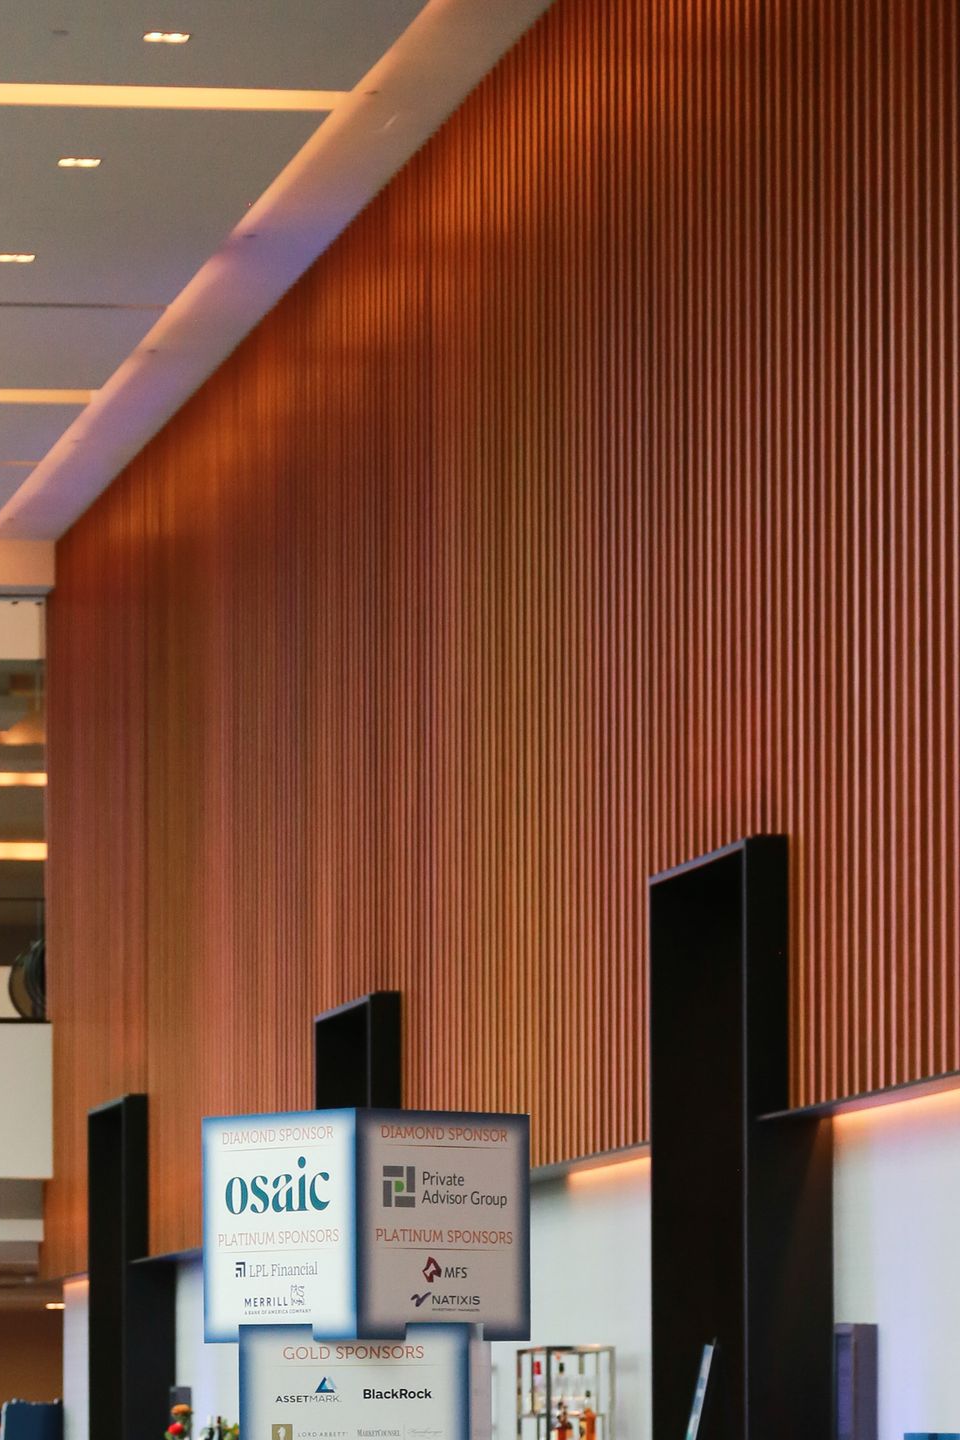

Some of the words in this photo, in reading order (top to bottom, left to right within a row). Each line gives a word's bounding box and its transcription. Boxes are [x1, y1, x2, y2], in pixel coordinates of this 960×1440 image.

[221, 1129, 276, 1145] DIAMOND
[279, 1125, 334, 1142] SPONSOR
[380, 1125, 444, 1140] DIAMOND
[448, 1127, 507, 1142] SPONSOR
[225, 1156, 331, 1215] osaic
[422, 1171, 465, 1187] Private
[421, 1190, 468, 1205] Advisor
[470, 1191, 507, 1208] Group
[218, 1231, 275, 1247] PLATINUM
[279, 1228, 340, 1244] SPONSORS
[375, 1228, 443, 1243] PLATINUM
[447, 1229, 513, 1245] SPONSORS
[249, 1264, 268, 1278] LPL
[271, 1261, 318, 1277] Financial
[444, 1267, 467, 1279] MFS
[244, 1296, 288, 1308] MERRILL
[432, 1295, 481, 1305] NATIXIS
[283, 1346, 330, 1360] GOLD
[336, 1345, 424, 1359] SPONSORS
[363, 1388, 432, 1400] BlackRock
